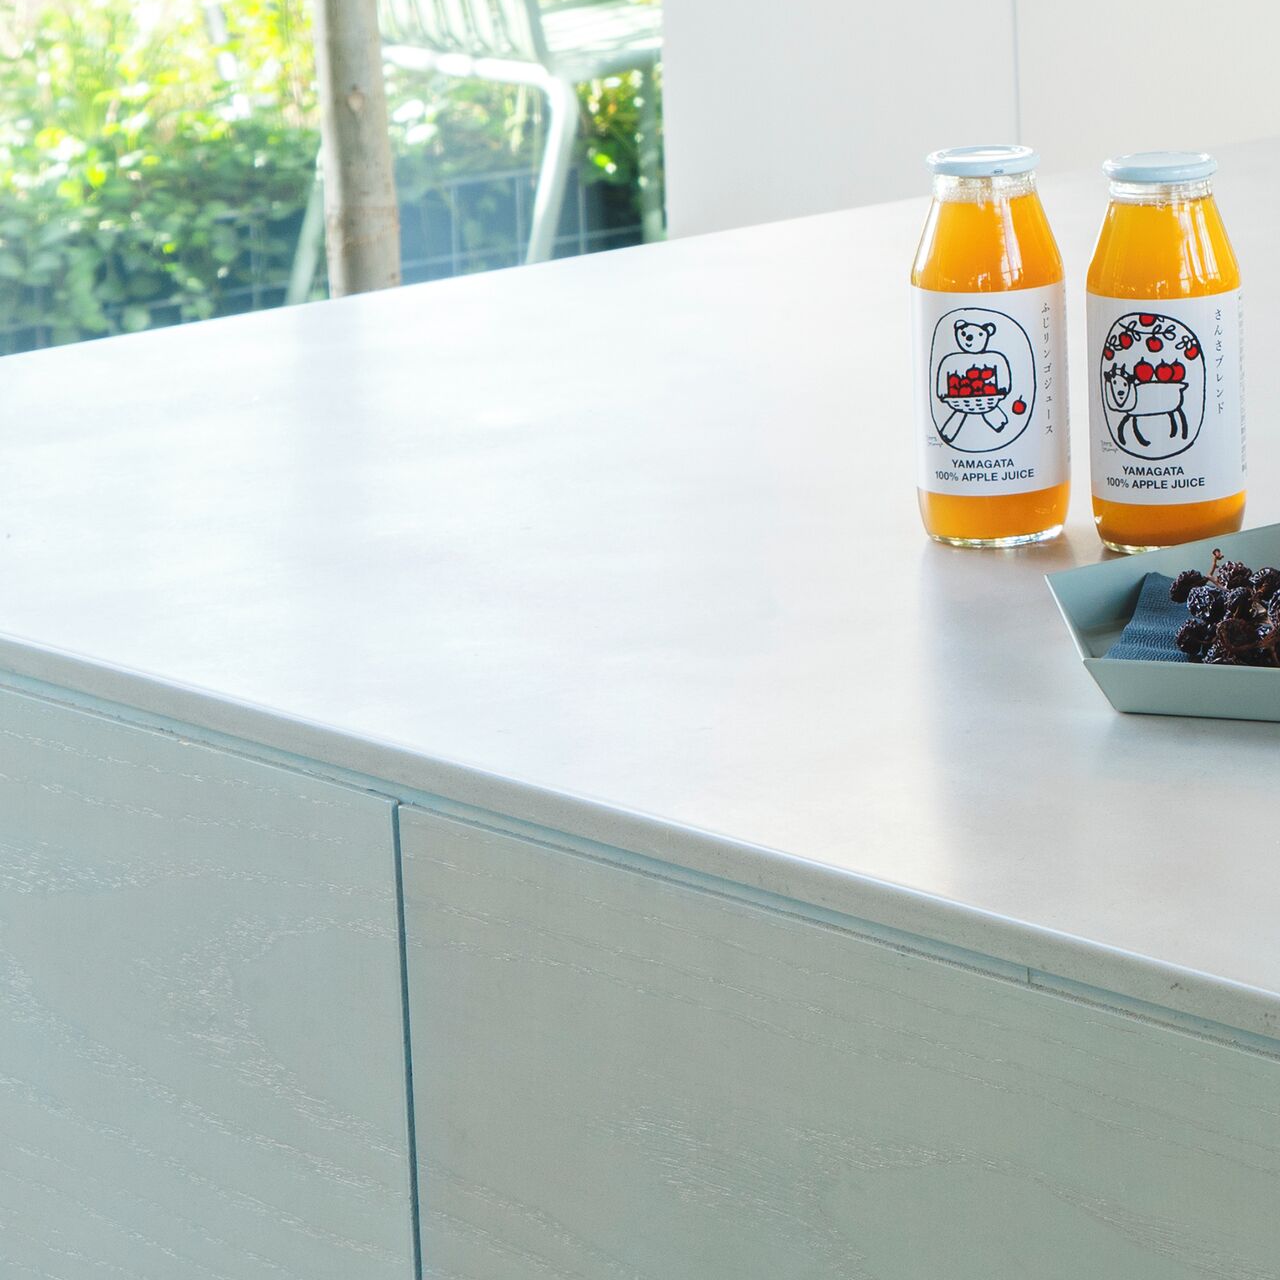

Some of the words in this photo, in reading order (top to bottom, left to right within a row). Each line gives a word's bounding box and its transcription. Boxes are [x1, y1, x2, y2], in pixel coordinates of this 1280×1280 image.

[951, 458, 1015, 470] YAMAGATA
[935, 470, 959, 482] 100%
[961, 472, 999, 482] APPLE
[1001, 468, 1035, 481] JUICE
[1122, 465, 1185, 476] YAMAGATA
[1106, 476, 1130, 489] 100%
[1131, 478, 1168, 489] APPLE
[1171, 477, 1206, 489] JUICE
